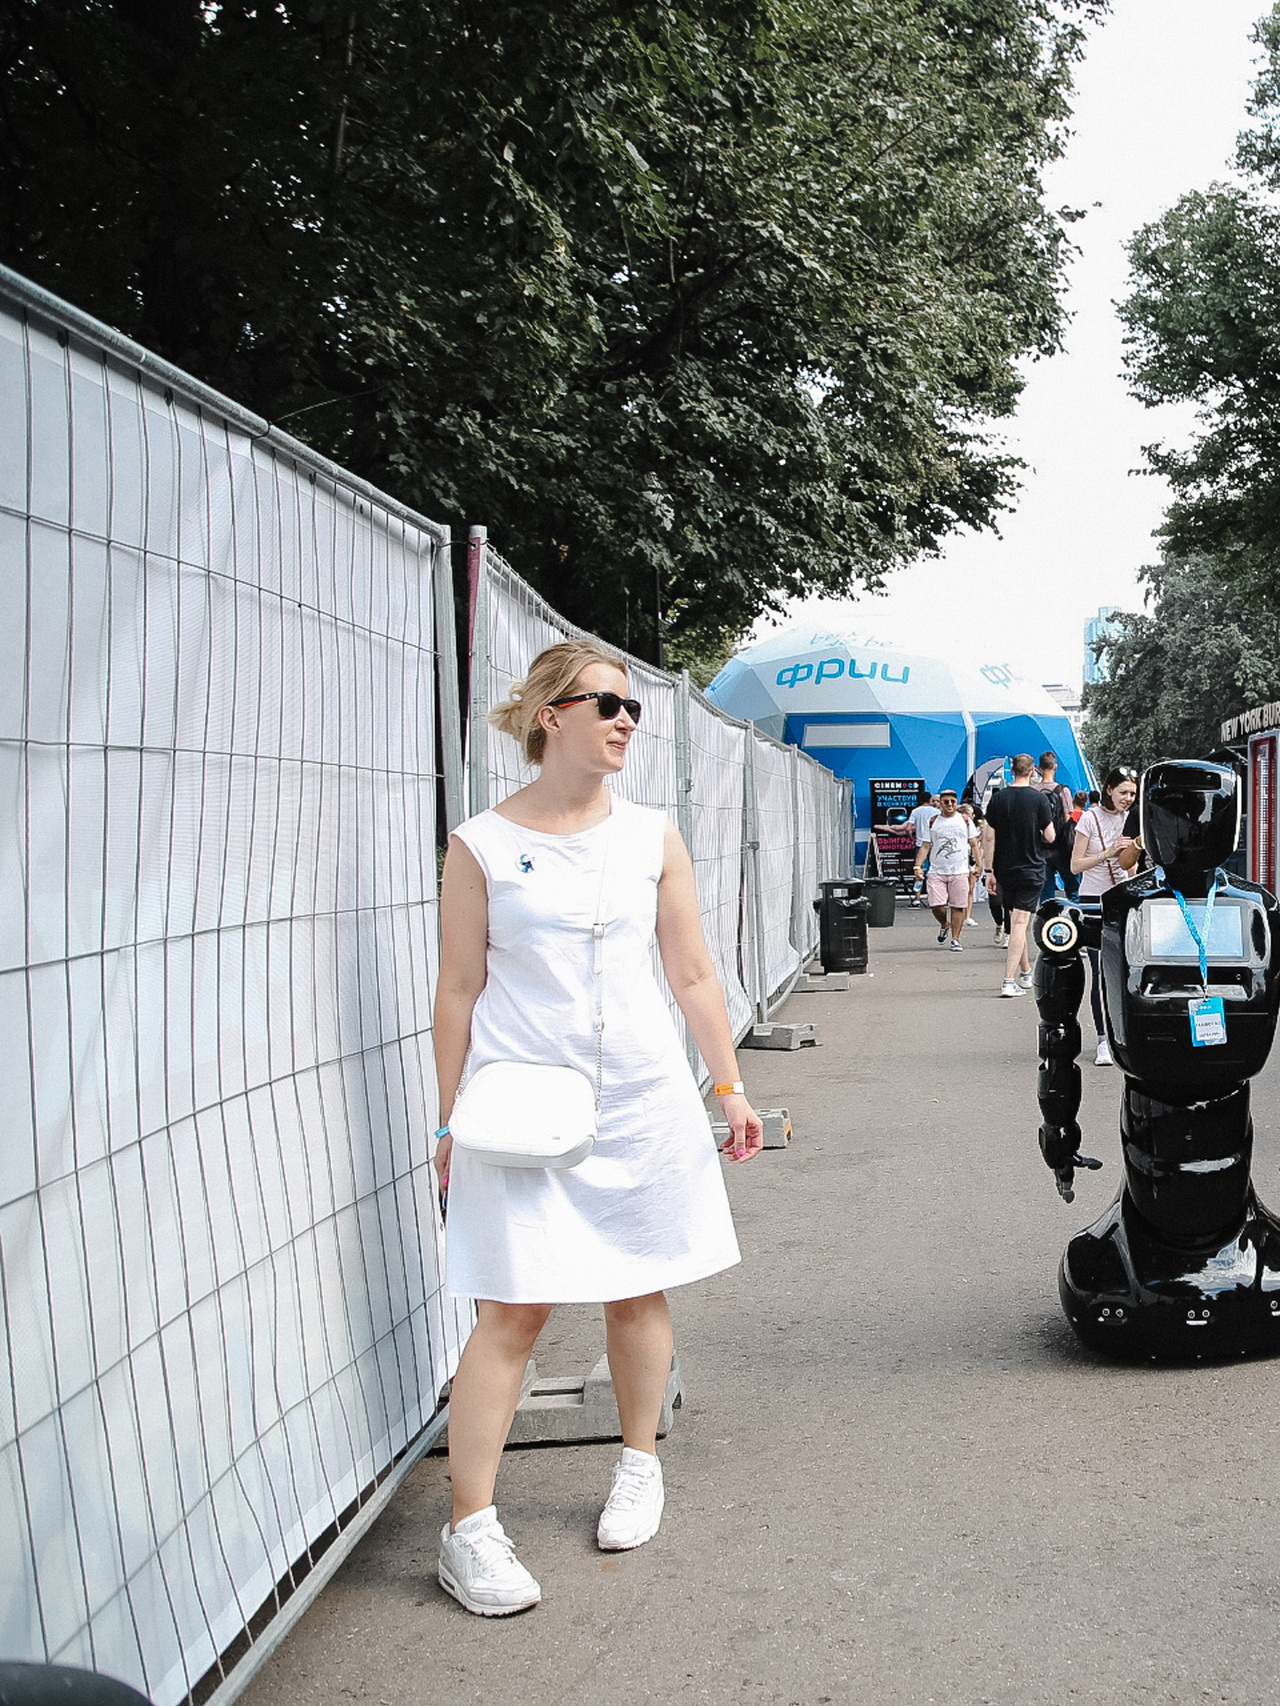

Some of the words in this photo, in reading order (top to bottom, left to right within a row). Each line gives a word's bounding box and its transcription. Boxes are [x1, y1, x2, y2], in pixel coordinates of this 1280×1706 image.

[1221, 717, 1240, 743] NEW
[1240, 707, 1263, 735] YORK
[877, 794, 917, 802] УЧАСТВУЙ
